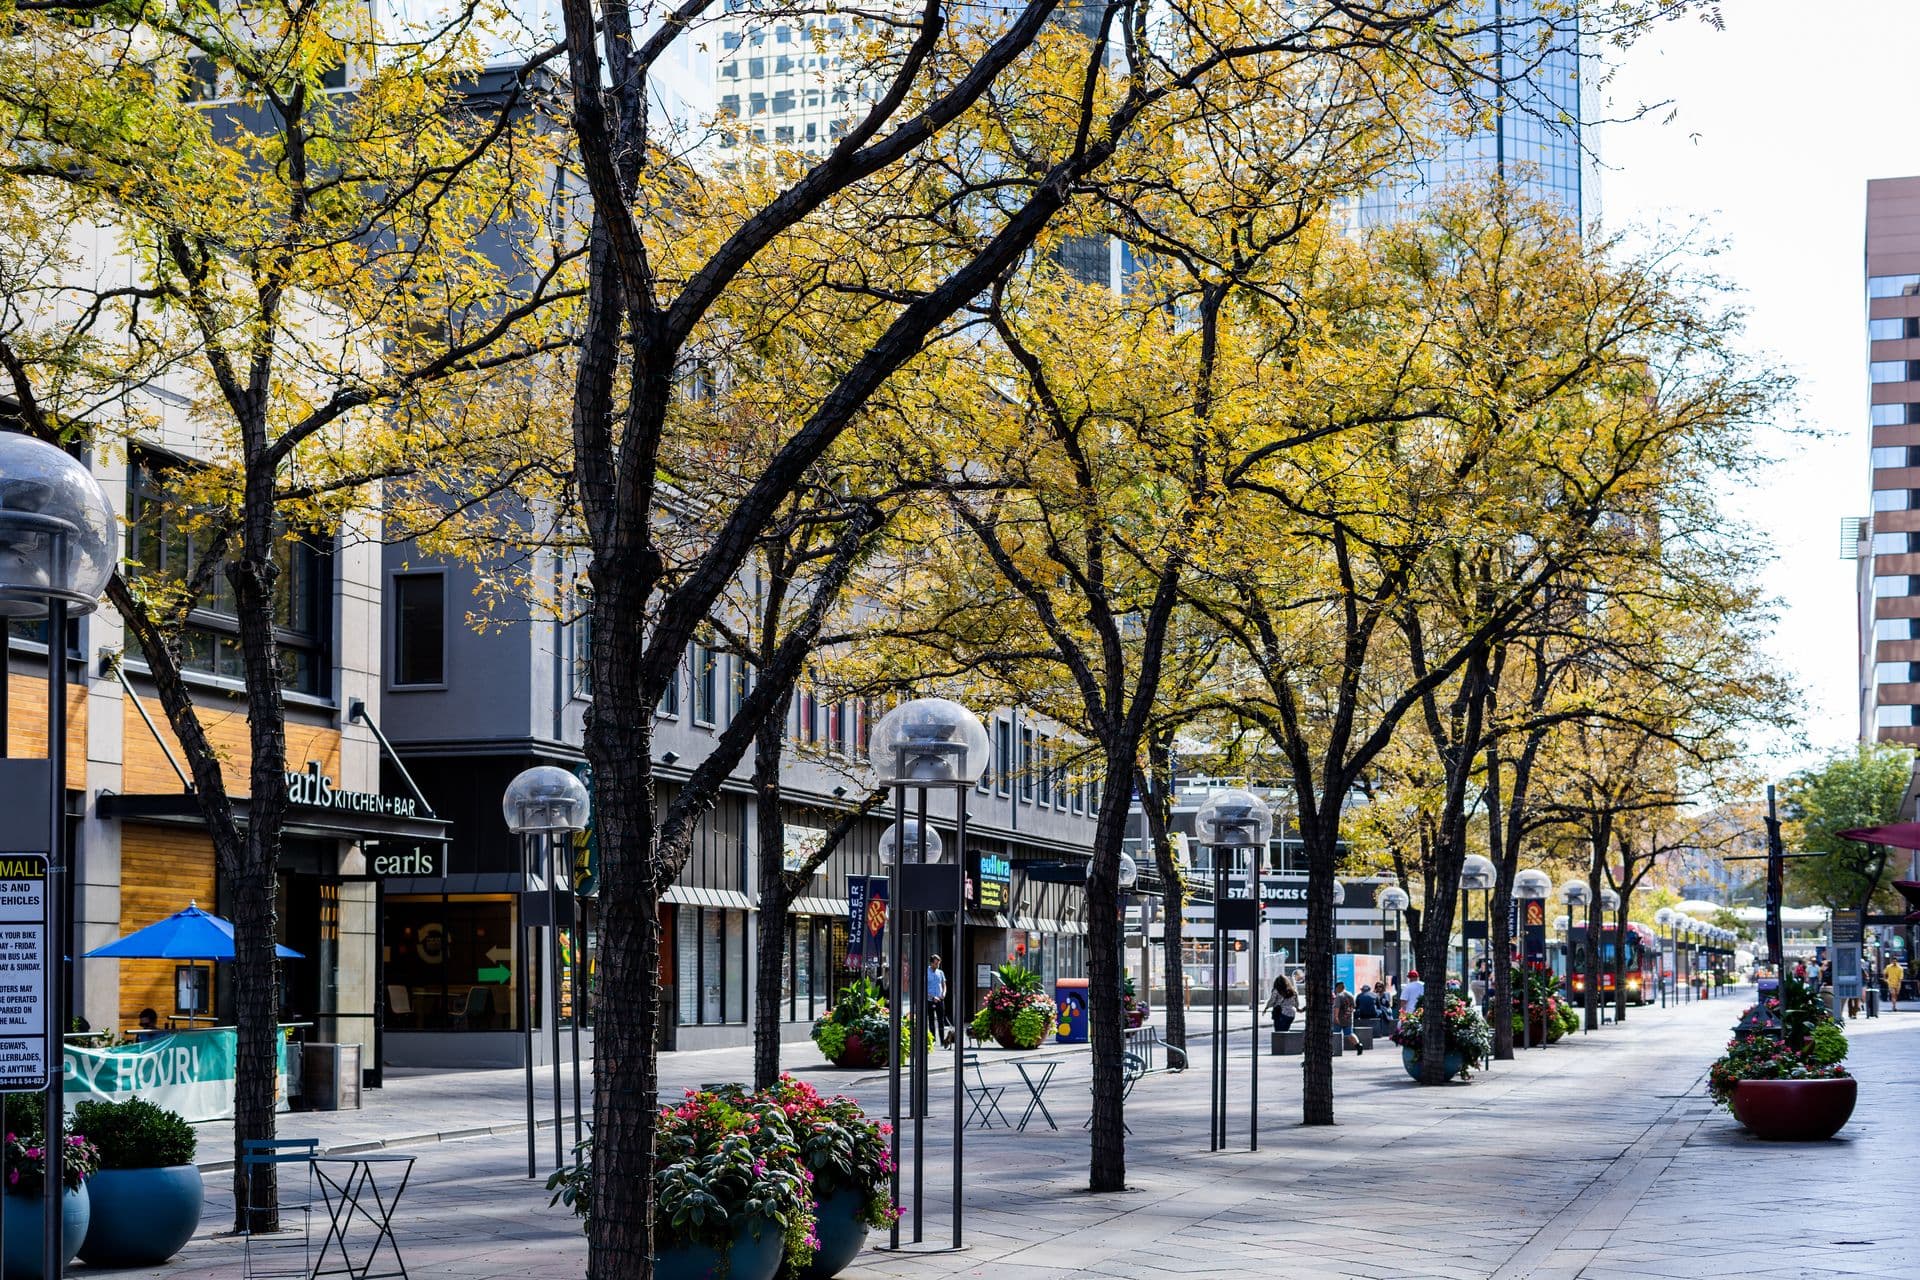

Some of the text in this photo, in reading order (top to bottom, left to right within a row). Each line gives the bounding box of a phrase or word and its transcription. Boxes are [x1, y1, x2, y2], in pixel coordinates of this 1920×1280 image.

[285, 761, 332, 807] arls
[335, 790, 384, 812] KITCHEN
[394, 797, 416, 816] BAR
[374, 847, 433, 875] earls
[0, 861, 44, 877] MALL
[10, 883, 31, 893] AND
[1228, 887, 1299, 899] STABUCKS
[0, 896, 40, 905] EHICLES
[5, 931, 21, 939] YOUR
[22, 931, 37, 939] BIKE
[14, 942, 37, 950] FRIDAY.
[0, 985, 33, 993] OTERS MAY
[6, 995, 37, 1004] OPERATED
[23, 1006, 32, 1014] ON
[0, 1017, 27, 1025] HE MALL.
[0, 1041, 28, 1051] EGWAYS,
[0, 1053, 41, 1062] LLERBLADES,
[7, 1064, 37, 1074] ANYTIME
[116, 1046, 199, 1093] HOUR!
